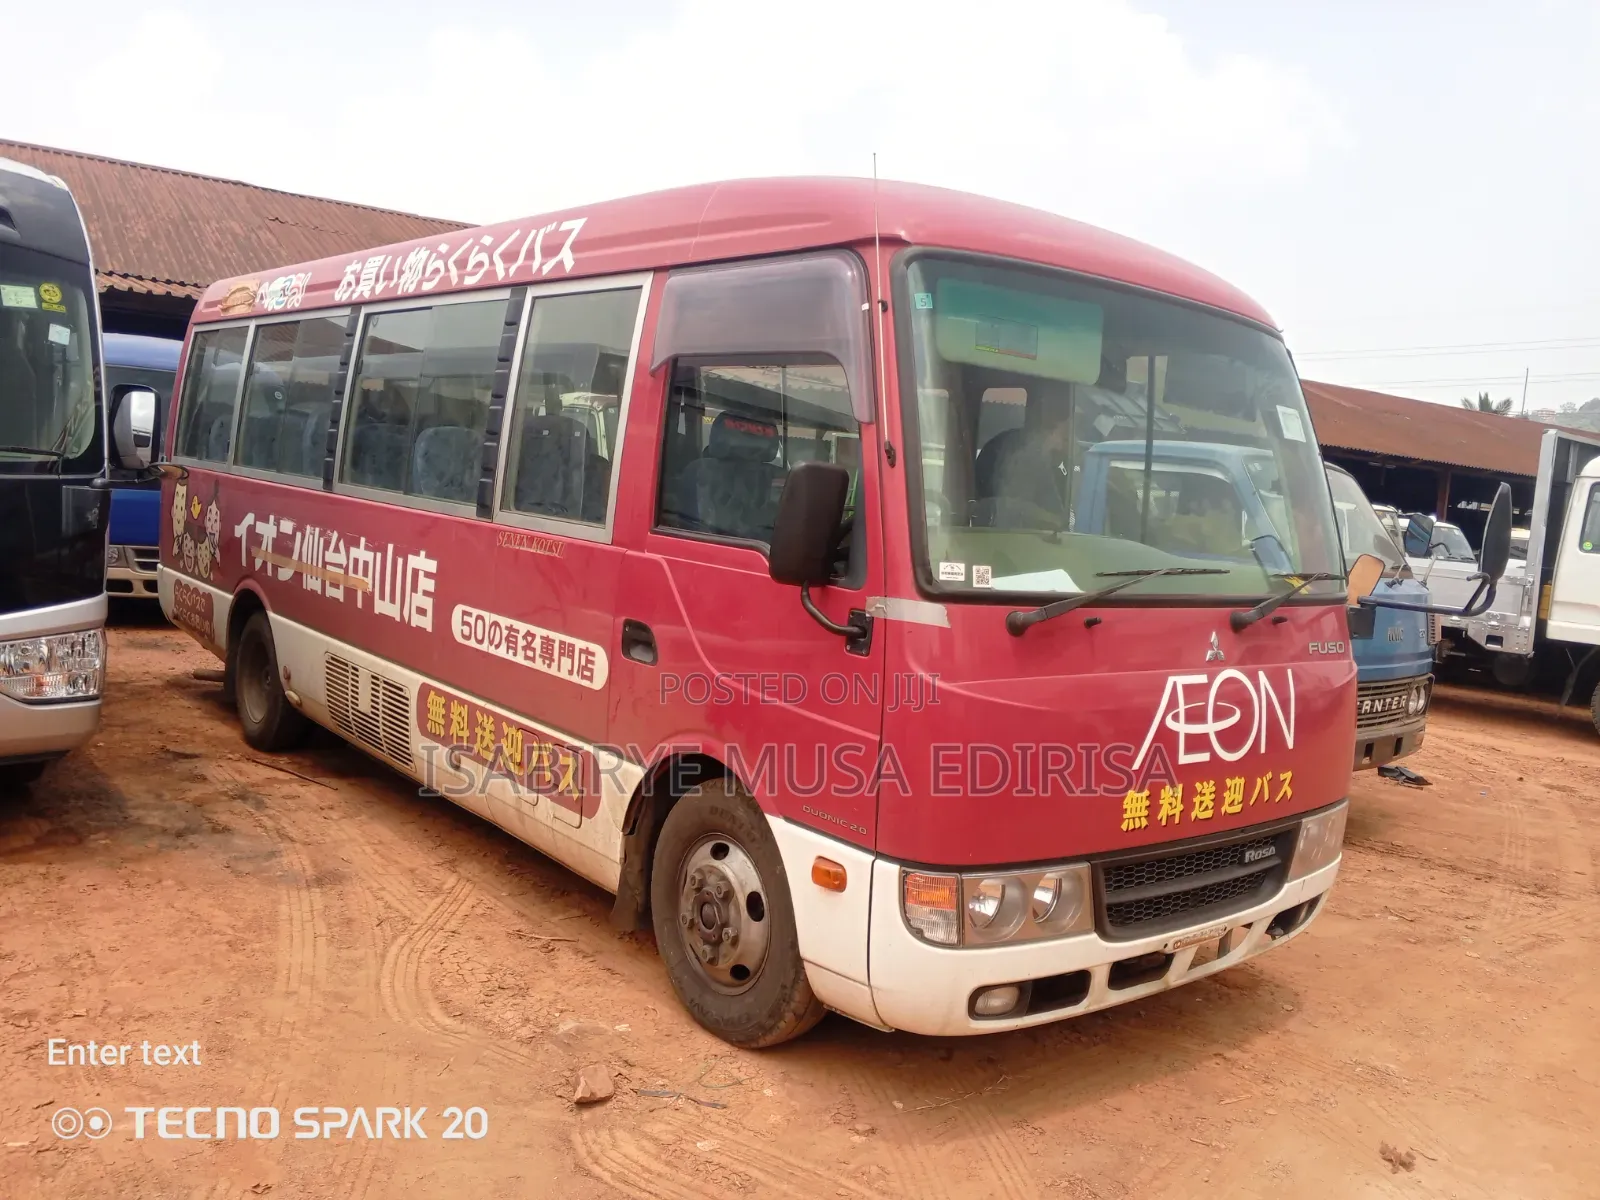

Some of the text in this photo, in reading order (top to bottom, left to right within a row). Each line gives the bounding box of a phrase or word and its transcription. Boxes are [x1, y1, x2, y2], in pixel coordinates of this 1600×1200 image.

[334, 217, 588, 302] お買い物らくらくバス
[234, 512, 438, 633] イオン仙台中山店
[460, 609, 597, 683] 50の有名専門店
[1308, 641, 1345, 655] FUSO
[1357, 695, 1408, 714] ANTER
[427, 690, 580, 801] 無料送迎バス
[802, 805, 848, 828] DUONIC
[1120, 770, 1294, 832] 無料送迎バス
